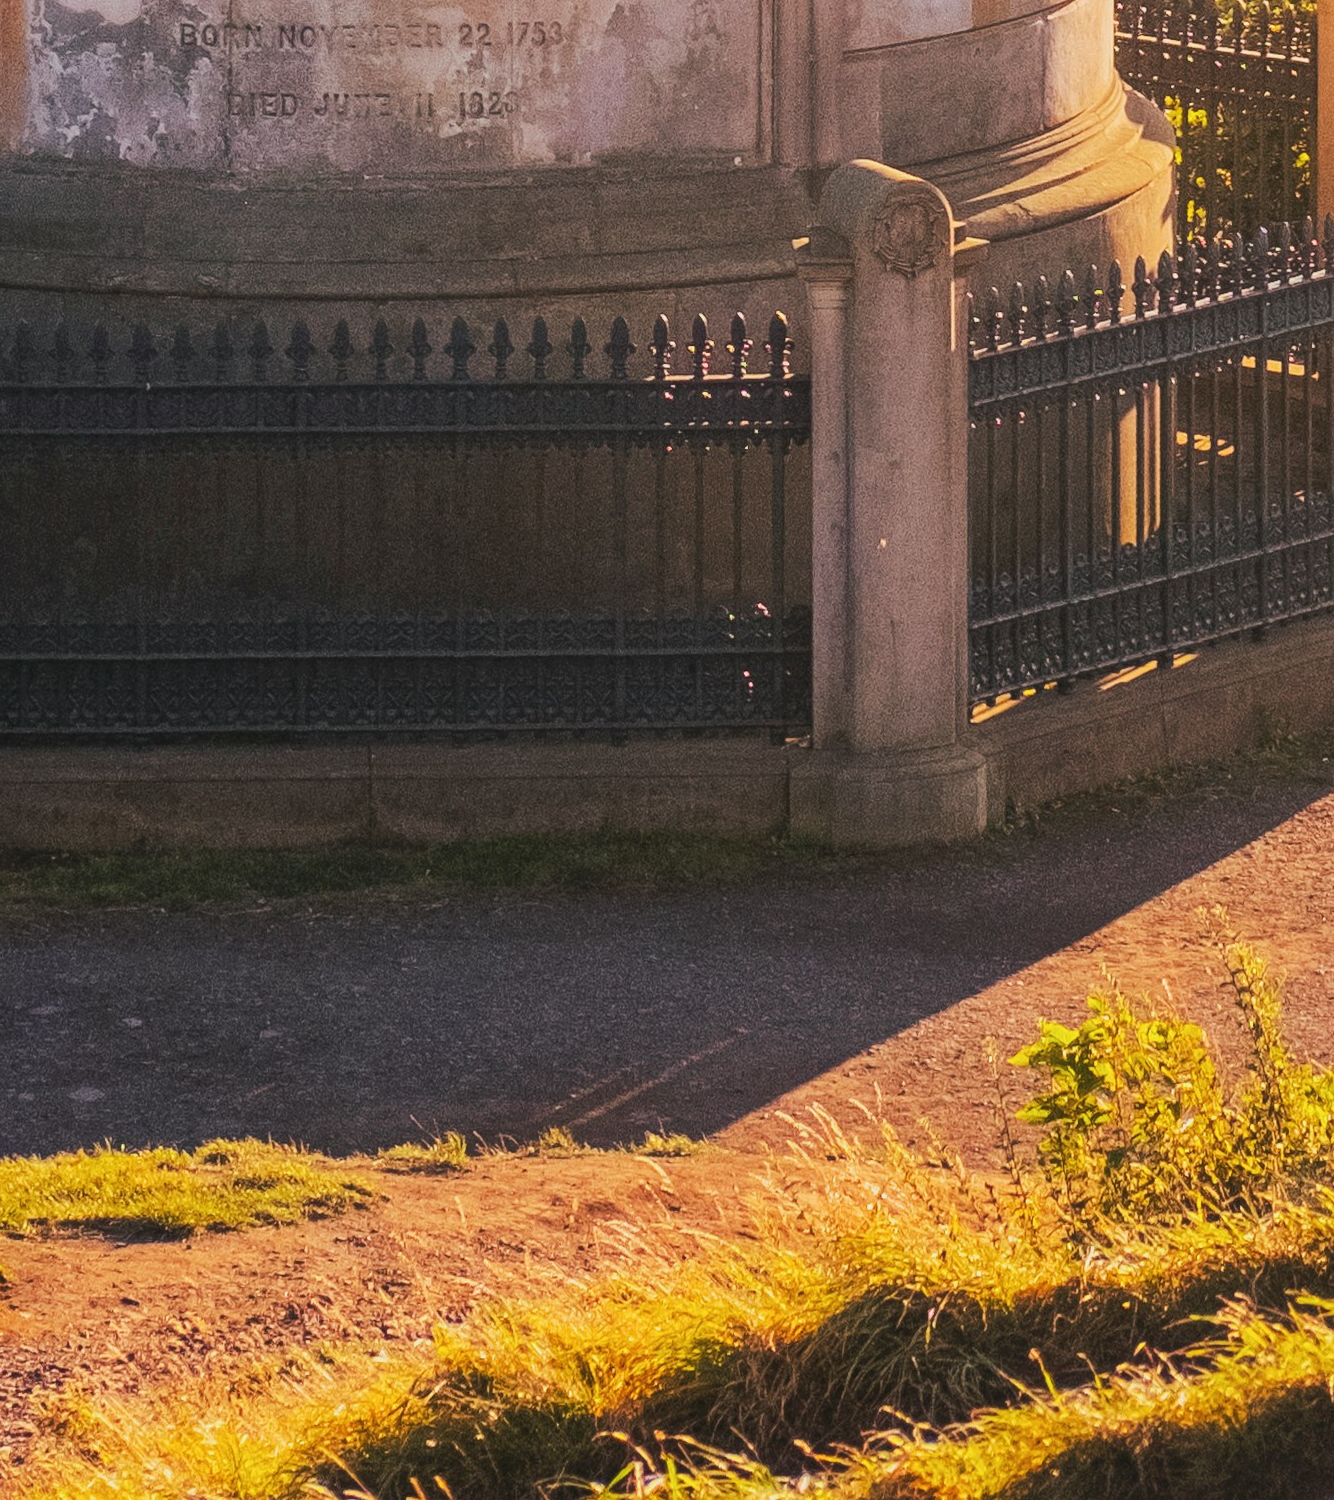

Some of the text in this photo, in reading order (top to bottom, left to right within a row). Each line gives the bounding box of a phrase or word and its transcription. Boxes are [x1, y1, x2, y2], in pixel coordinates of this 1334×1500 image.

[180, 23, 262, 48] BORN
[458, 22, 492, 47] 22
[507, 20, 562, 46] 1753
[228, 93, 296, 117] DIED
